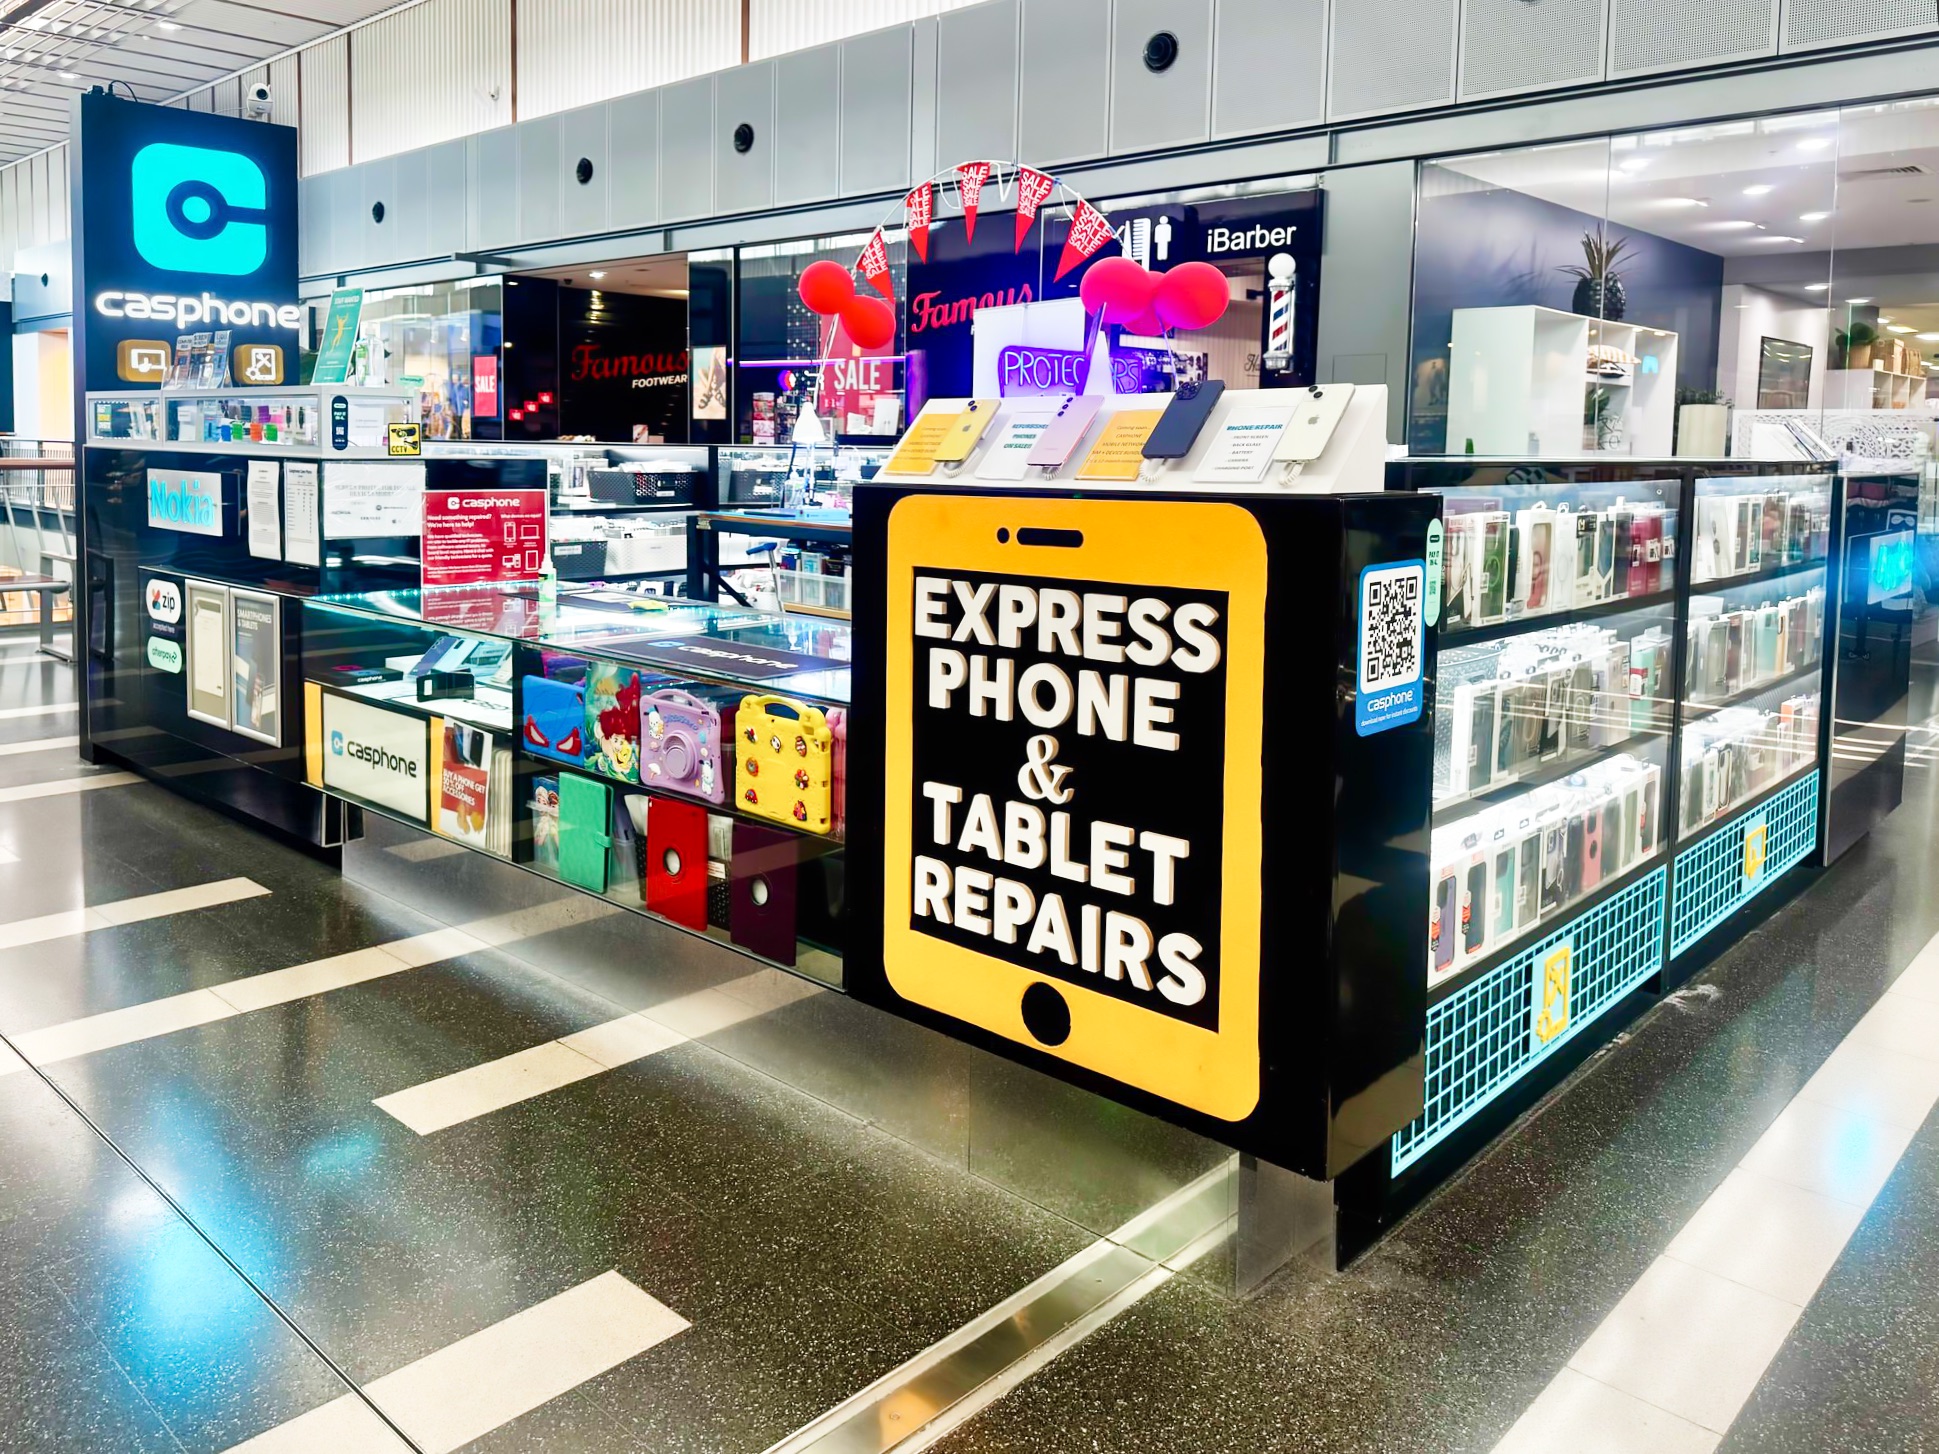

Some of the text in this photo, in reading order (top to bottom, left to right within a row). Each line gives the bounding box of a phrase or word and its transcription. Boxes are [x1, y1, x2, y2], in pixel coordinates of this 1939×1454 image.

[962, 166, 988, 180] SALE
[1021, 172, 1052, 194] SALE
[1076, 216, 1106, 243] SALE
[1081, 204, 1112, 236] SALE
[1068, 236, 1090, 258] SALE
[1207, 224, 1296, 252] iBarber
[96, 291, 300, 330] casphone
[912, 284, 1033, 332] Famous
[572, 344, 689, 380] Famous
[834, 360, 881, 390] SALE
[474, 376, 496, 392] SALE
[632, 374, 688, 388] FOOTWEAR
[150, 476, 214, 527] Nokia
[462, 497, 520, 510] casphone
[162, 592, 175, 612] zip
[237, 608, 272, 623] SMARTPHONES
[242, 620, 258, 630] TABLETS
[914, 576, 1220, 674] EXPRESS
[677, 646, 799, 670] casphone
[357, 674, 383, 683] casphone
[928, 647, 1180, 752] PHONE
[1367, 690, 1414, 712] casphone
[347, 740, 417, 778] casphone
[1017, 734, 1074, 805] &
[922, 781, 1190, 906] TABLET
[914, 854, 1206, 1006] REPAIRS
